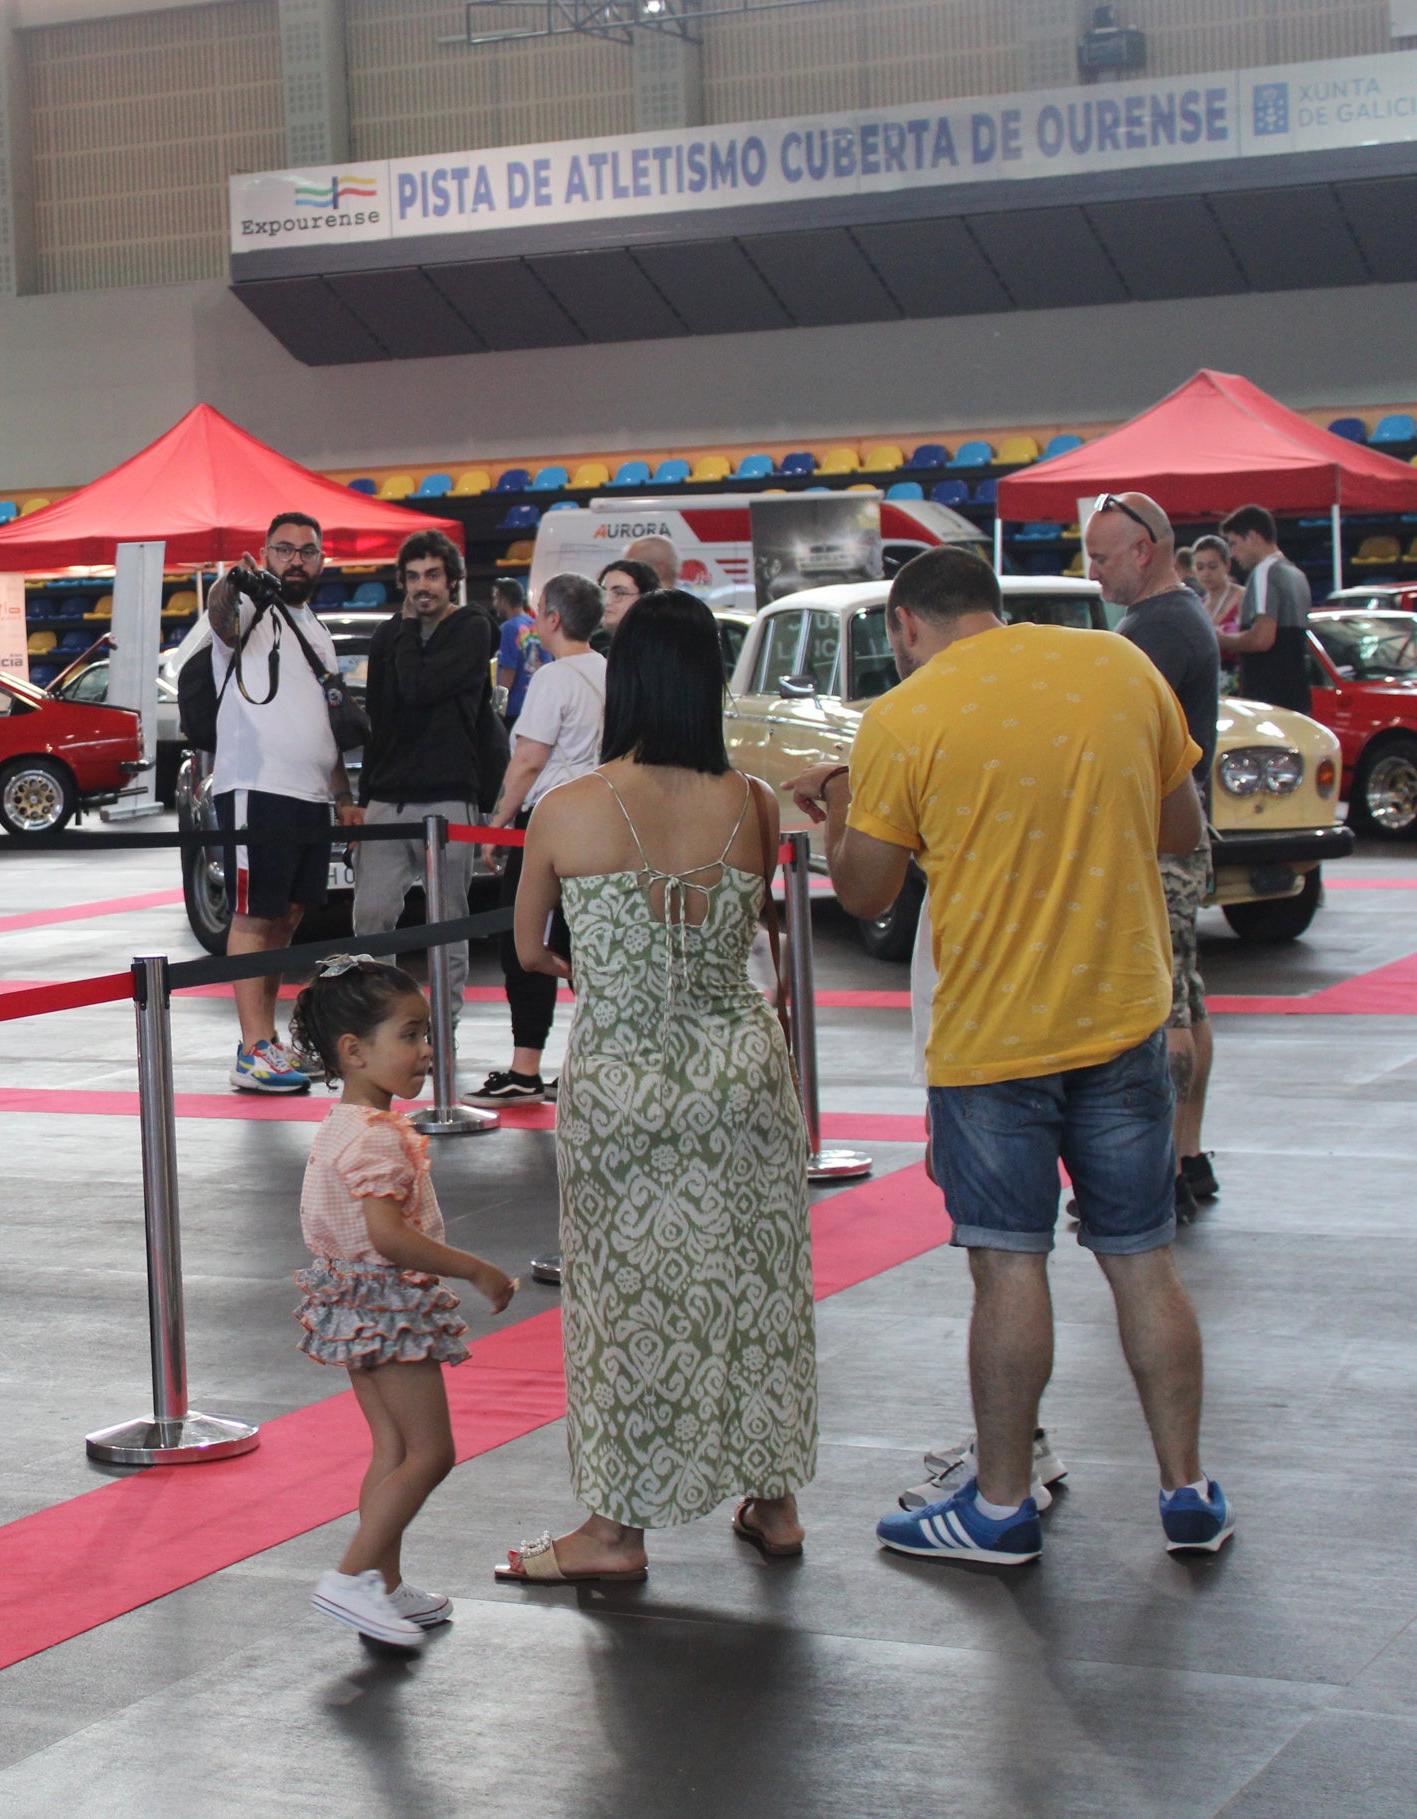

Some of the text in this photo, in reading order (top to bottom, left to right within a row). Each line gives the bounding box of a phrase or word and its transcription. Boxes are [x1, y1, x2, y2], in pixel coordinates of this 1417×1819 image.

[1298, 78, 1380, 102] XUNTA
[1297, 107, 1329, 127] DE
[398, 87, 1229, 220] PISTA DE ATLETISMO CUBERTA DE OURENSE
[241, 209, 381, 237] Expourense
[593, 522, 673, 540] AURORA
